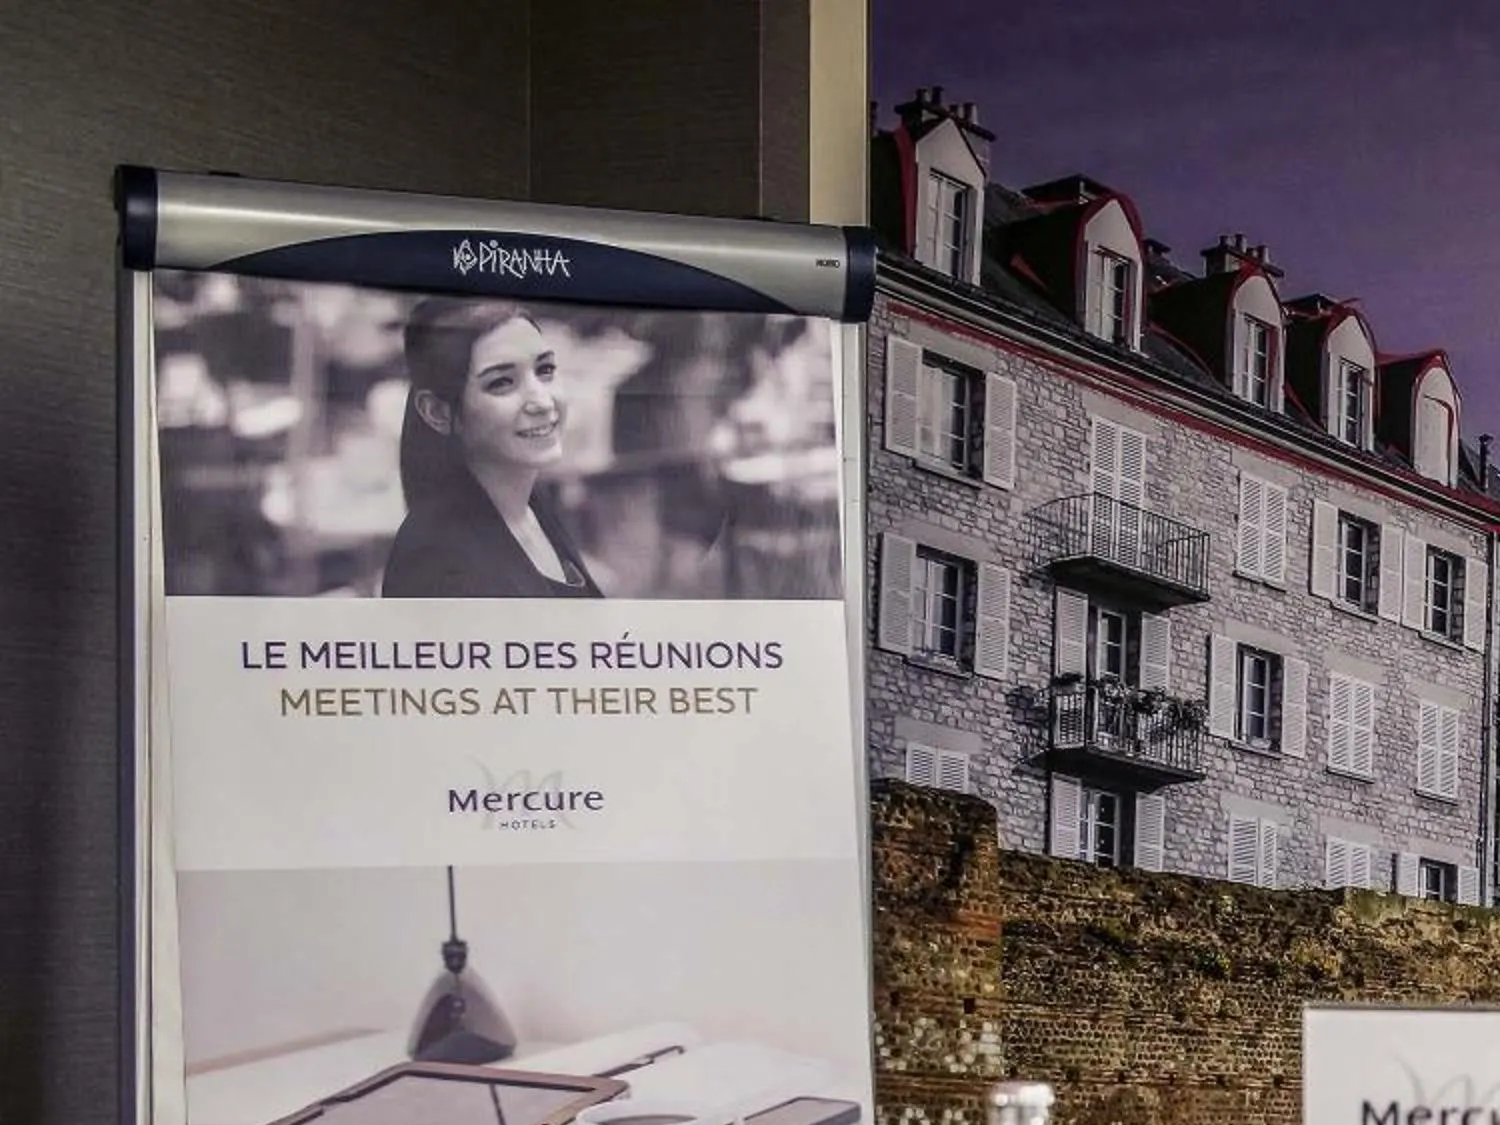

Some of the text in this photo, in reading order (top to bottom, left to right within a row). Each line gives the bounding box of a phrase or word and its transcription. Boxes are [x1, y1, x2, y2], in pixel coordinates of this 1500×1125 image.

[240, 632, 784, 670] LE MEILLEUR DES RÉUNIONS
[281, 687, 758, 717] MEETINGS AT THEIR BEST
[448, 788, 605, 813] Mercure
[500, 818, 556, 831] HOTELS
